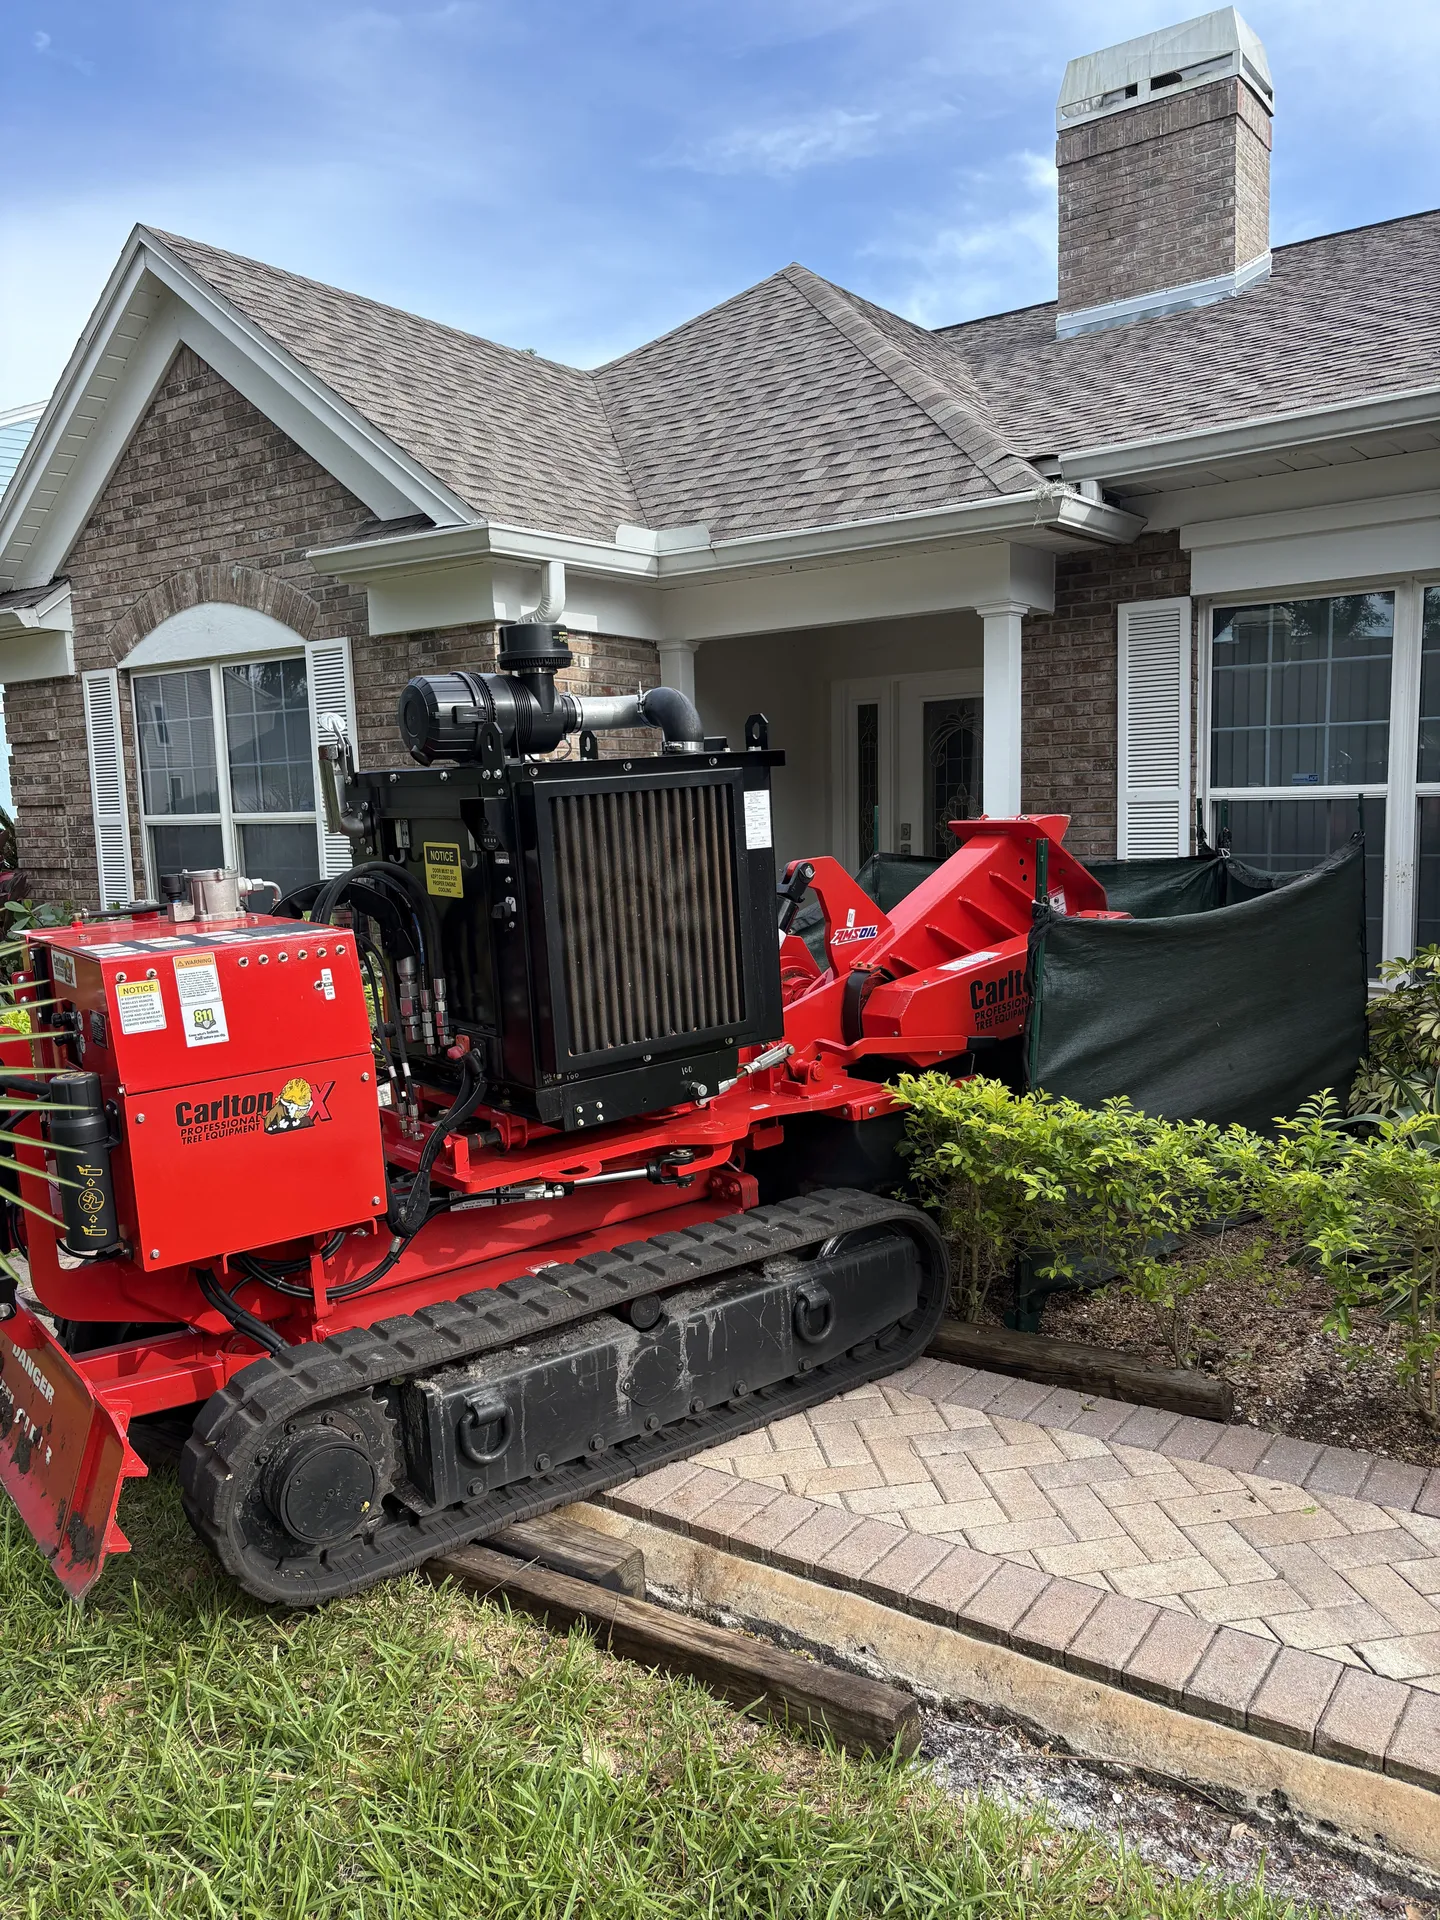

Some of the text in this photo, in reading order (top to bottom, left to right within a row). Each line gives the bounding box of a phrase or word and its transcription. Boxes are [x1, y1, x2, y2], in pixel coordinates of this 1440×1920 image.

[430, 850, 454, 862] NOTICE
[831, 926, 877, 944] AMSOIL
[184, 957, 212, 966] WARNING
[123, 984, 155, 995] NOTICE
[969, 969, 1024, 1010] Carlt
[193, 1008, 214, 1024] 811
[974, 995, 1029, 1022] PROFESSION
[976, 1007, 1026, 1032] TREE EQUIPM
[681, 1065, 693, 1075] 100
[175, 1091, 273, 1127] Carlton
[180, 1114, 261, 1137] PROFESSIONAL
[181, 1122, 260, 1145] TREE EQUIPMENT
[12, 1343, 55, 1405] DANGER
